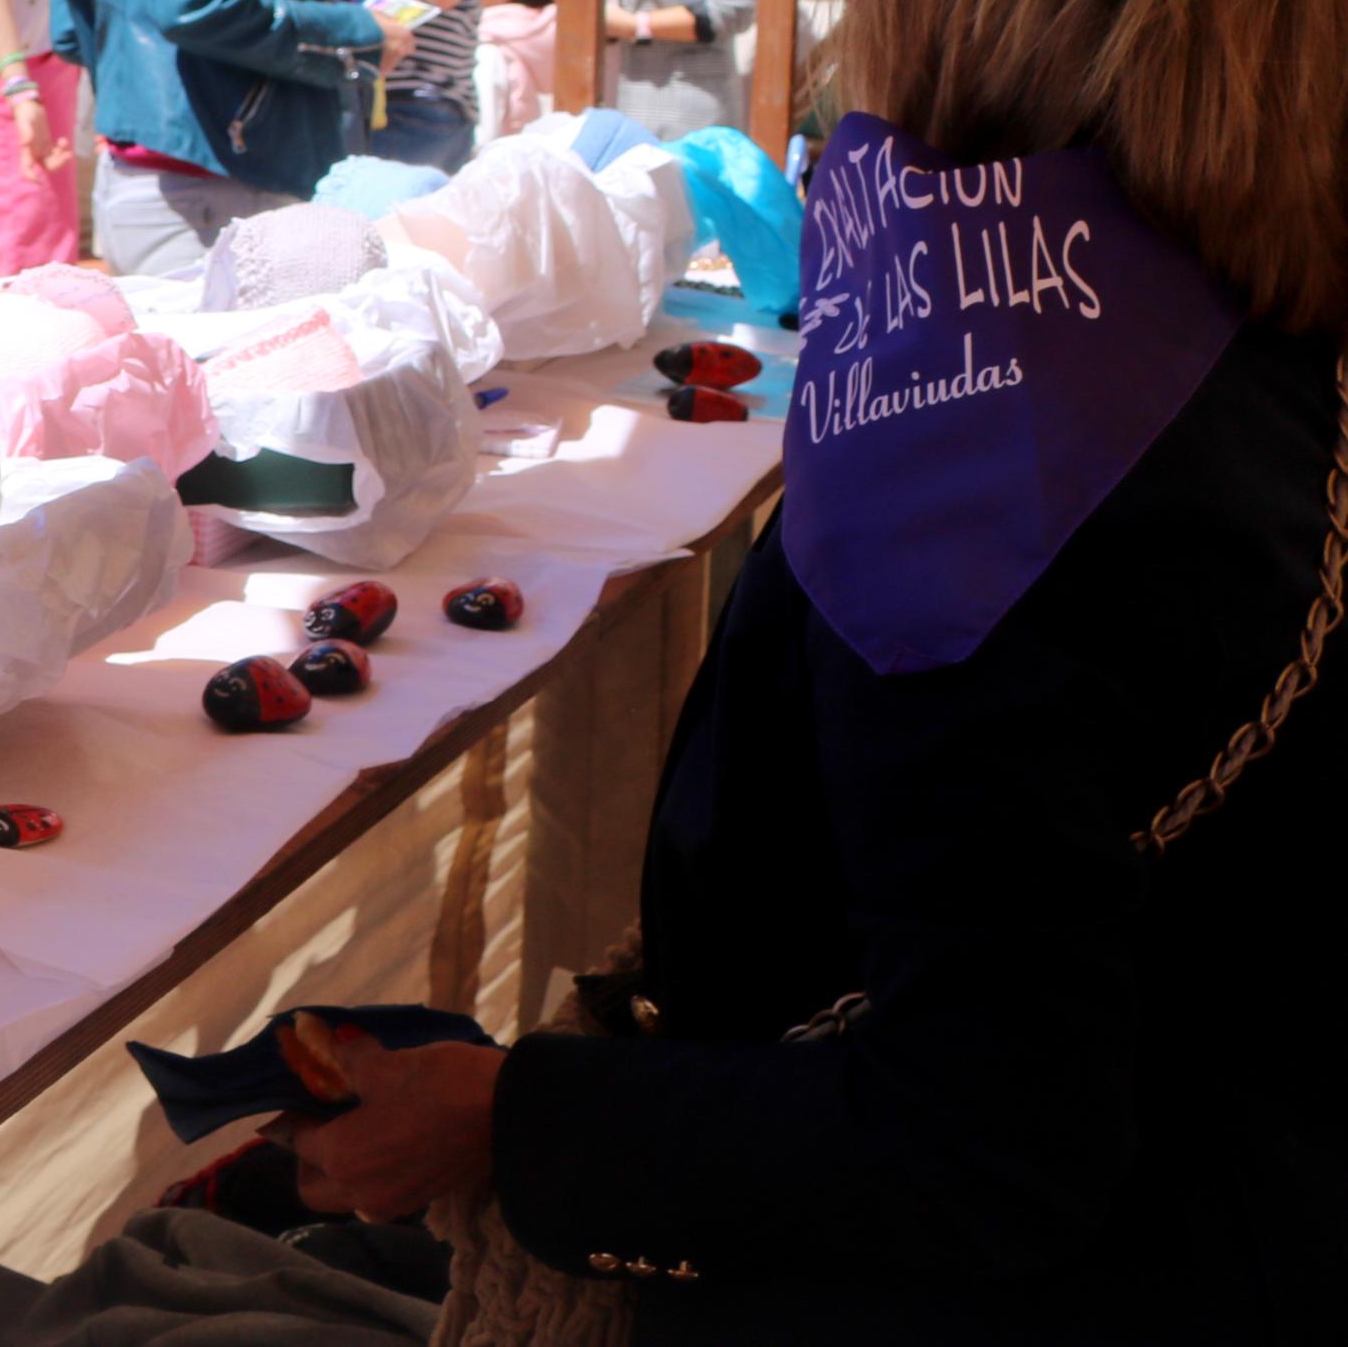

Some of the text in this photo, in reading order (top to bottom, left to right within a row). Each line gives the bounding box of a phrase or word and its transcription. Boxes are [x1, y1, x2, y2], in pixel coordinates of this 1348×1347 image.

[886, 239, 933, 334] LAS
[950, 213, 1102, 320] LILAS
[800, 331, 1025, 445] Villaviudas
